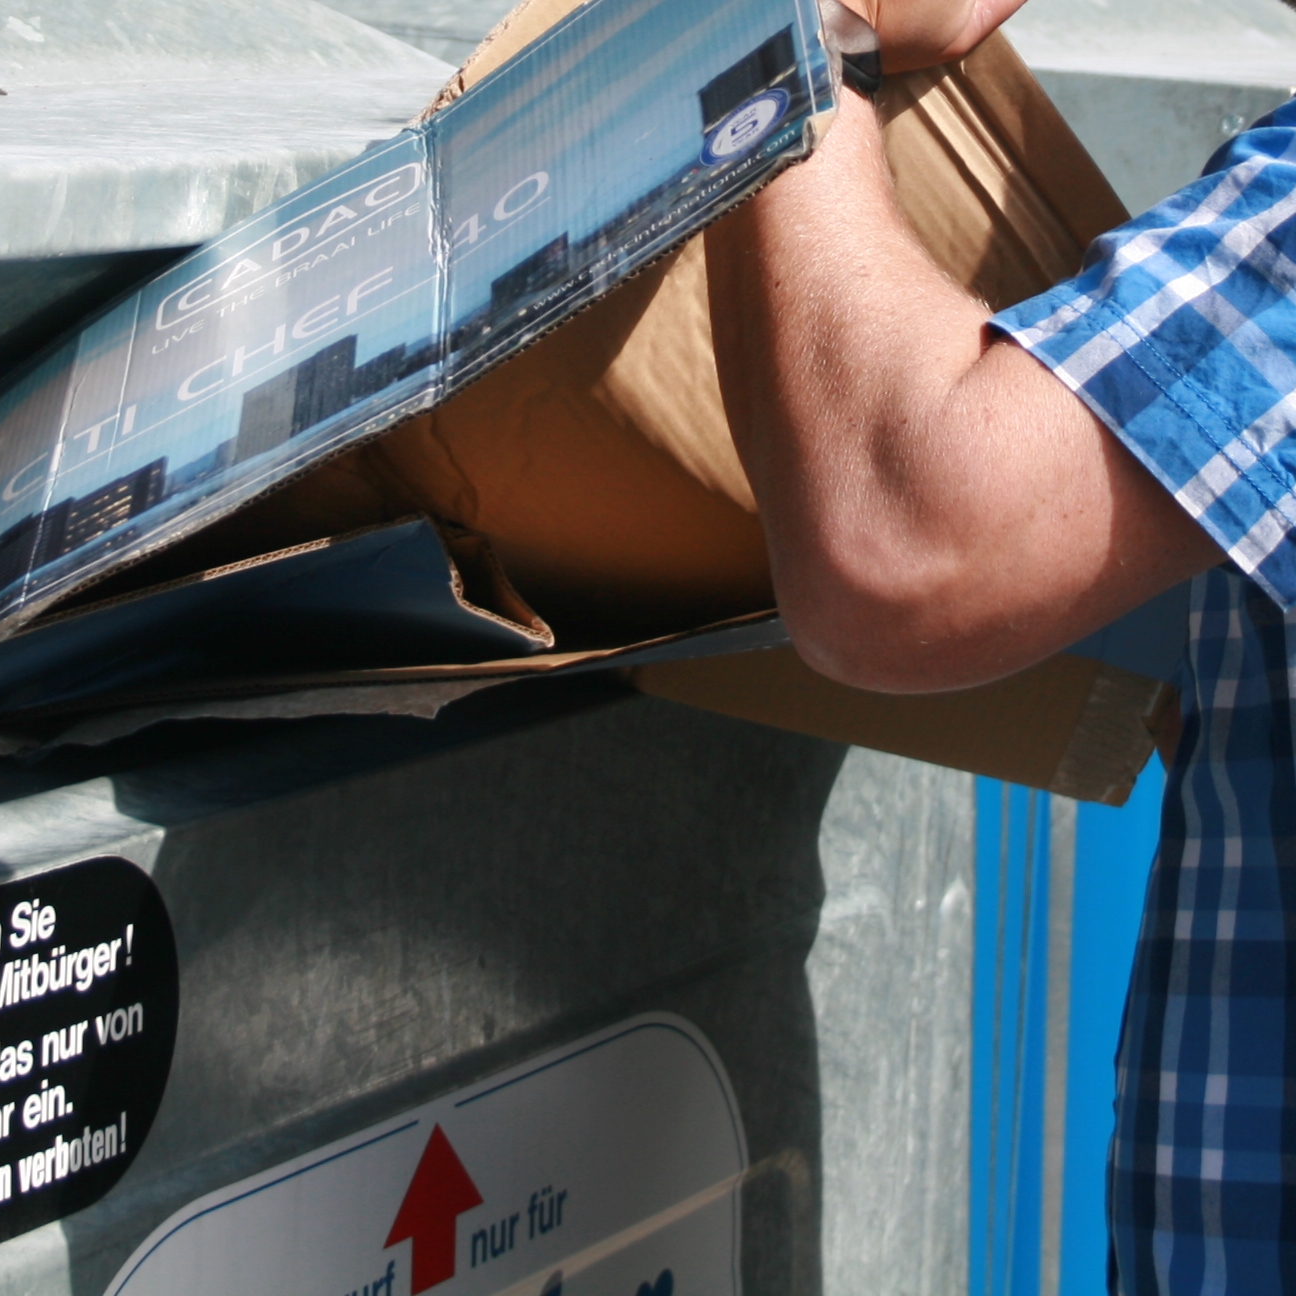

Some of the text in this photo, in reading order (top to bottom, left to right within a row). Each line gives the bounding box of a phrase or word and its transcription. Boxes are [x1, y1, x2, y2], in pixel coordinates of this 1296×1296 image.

[730, 113, 759, 144] 5
[177, 176, 401, 311] CADAC
[533, 129, 797, 311] www.cadacinternational.com
[152, 202, 421, 355] LIVE THE BRAAI LIFE
[177, 266, 394, 402] CHEF
[452, 170, 549, 250] 40
[10, 899, 57, 949] Sie
[41, 1020, 88, 1067] nur
[95, 1002, 143, 1047] von
[22, 1080, 74, 1131] ein.
[18, 1111, 127, 1192] verboten!
[470, 1183, 568, 1268] nur für
